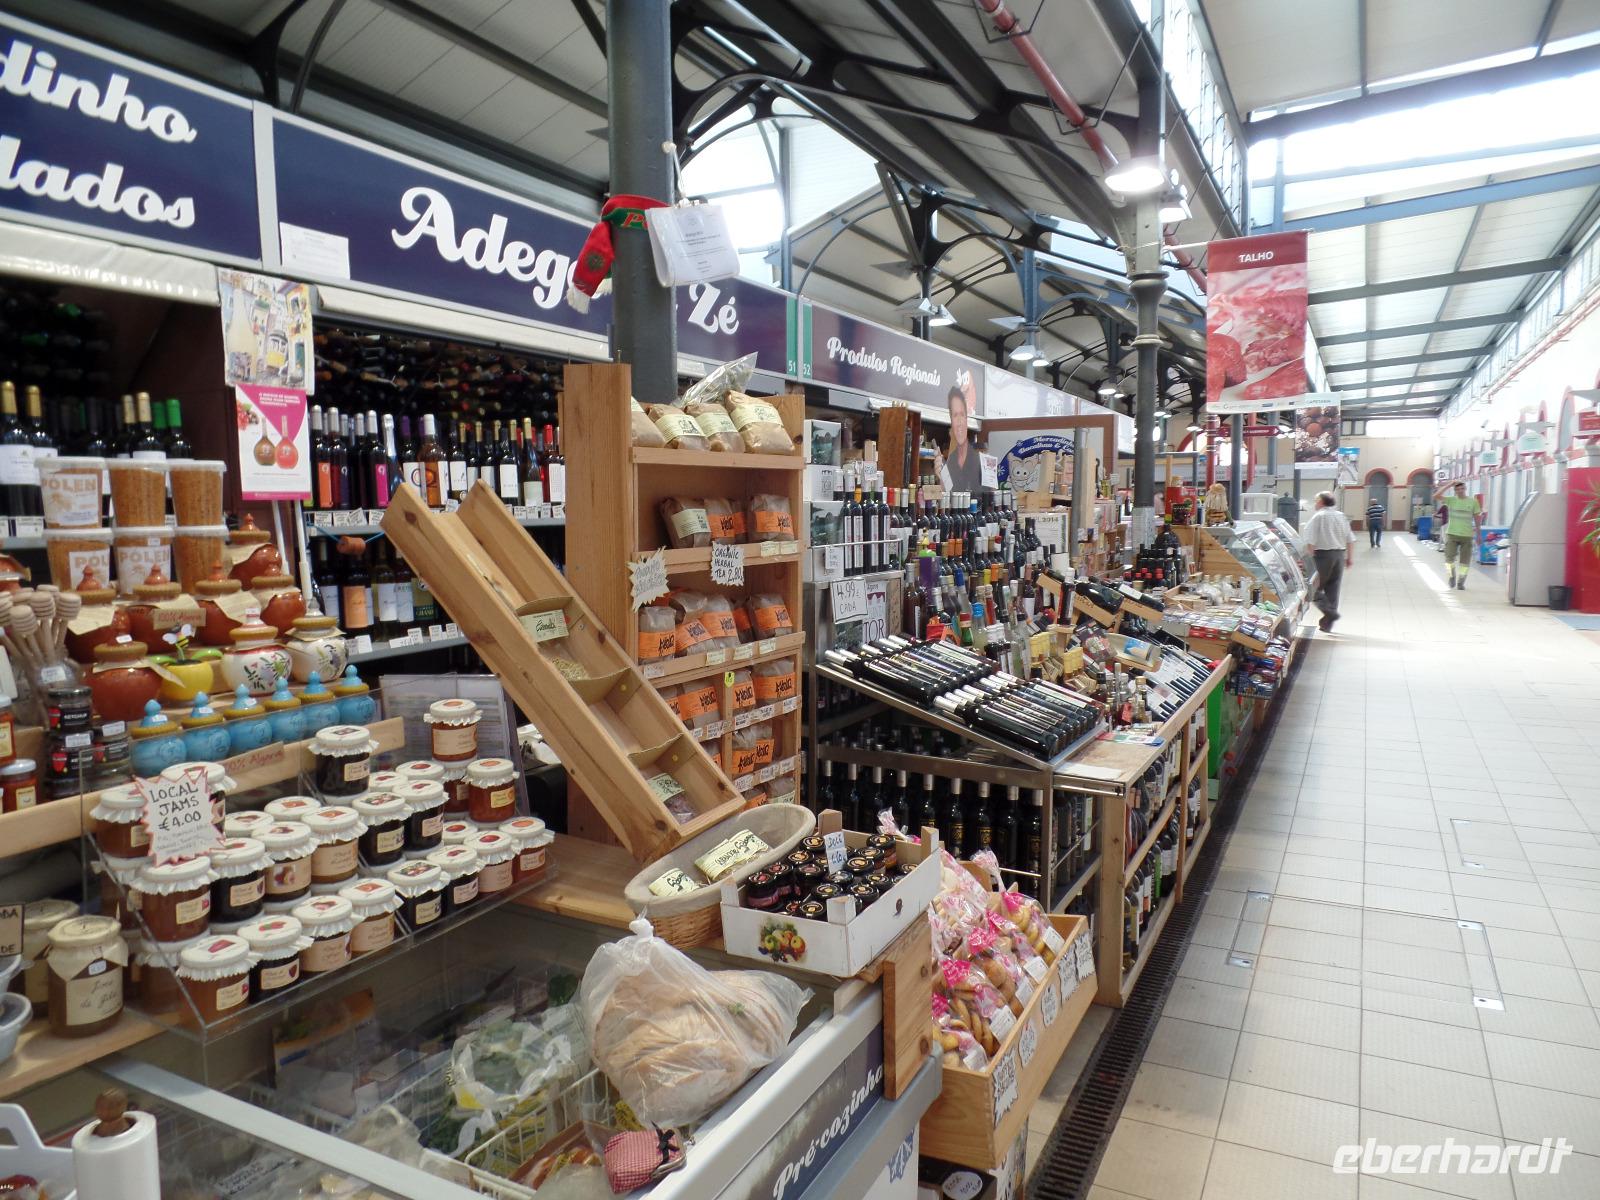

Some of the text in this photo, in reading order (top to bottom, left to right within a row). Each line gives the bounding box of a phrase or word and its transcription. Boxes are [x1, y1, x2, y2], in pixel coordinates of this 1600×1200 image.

[391, 187, 600, 309] Adeg
[688, 282, 740, 335] Zé
[1239, 251, 1274, 263] TALHO
[788, 360, 796, 373] 51
[803, 363, 811, 375] 52
[827, 337, 888, 373] Produtos
[890, 355, 941, 387] Regionais
[715, 570, 726, 578] TEA
[149, 782, 199, 803] LOCAL
[159, 796, 200, 816] JAMS
